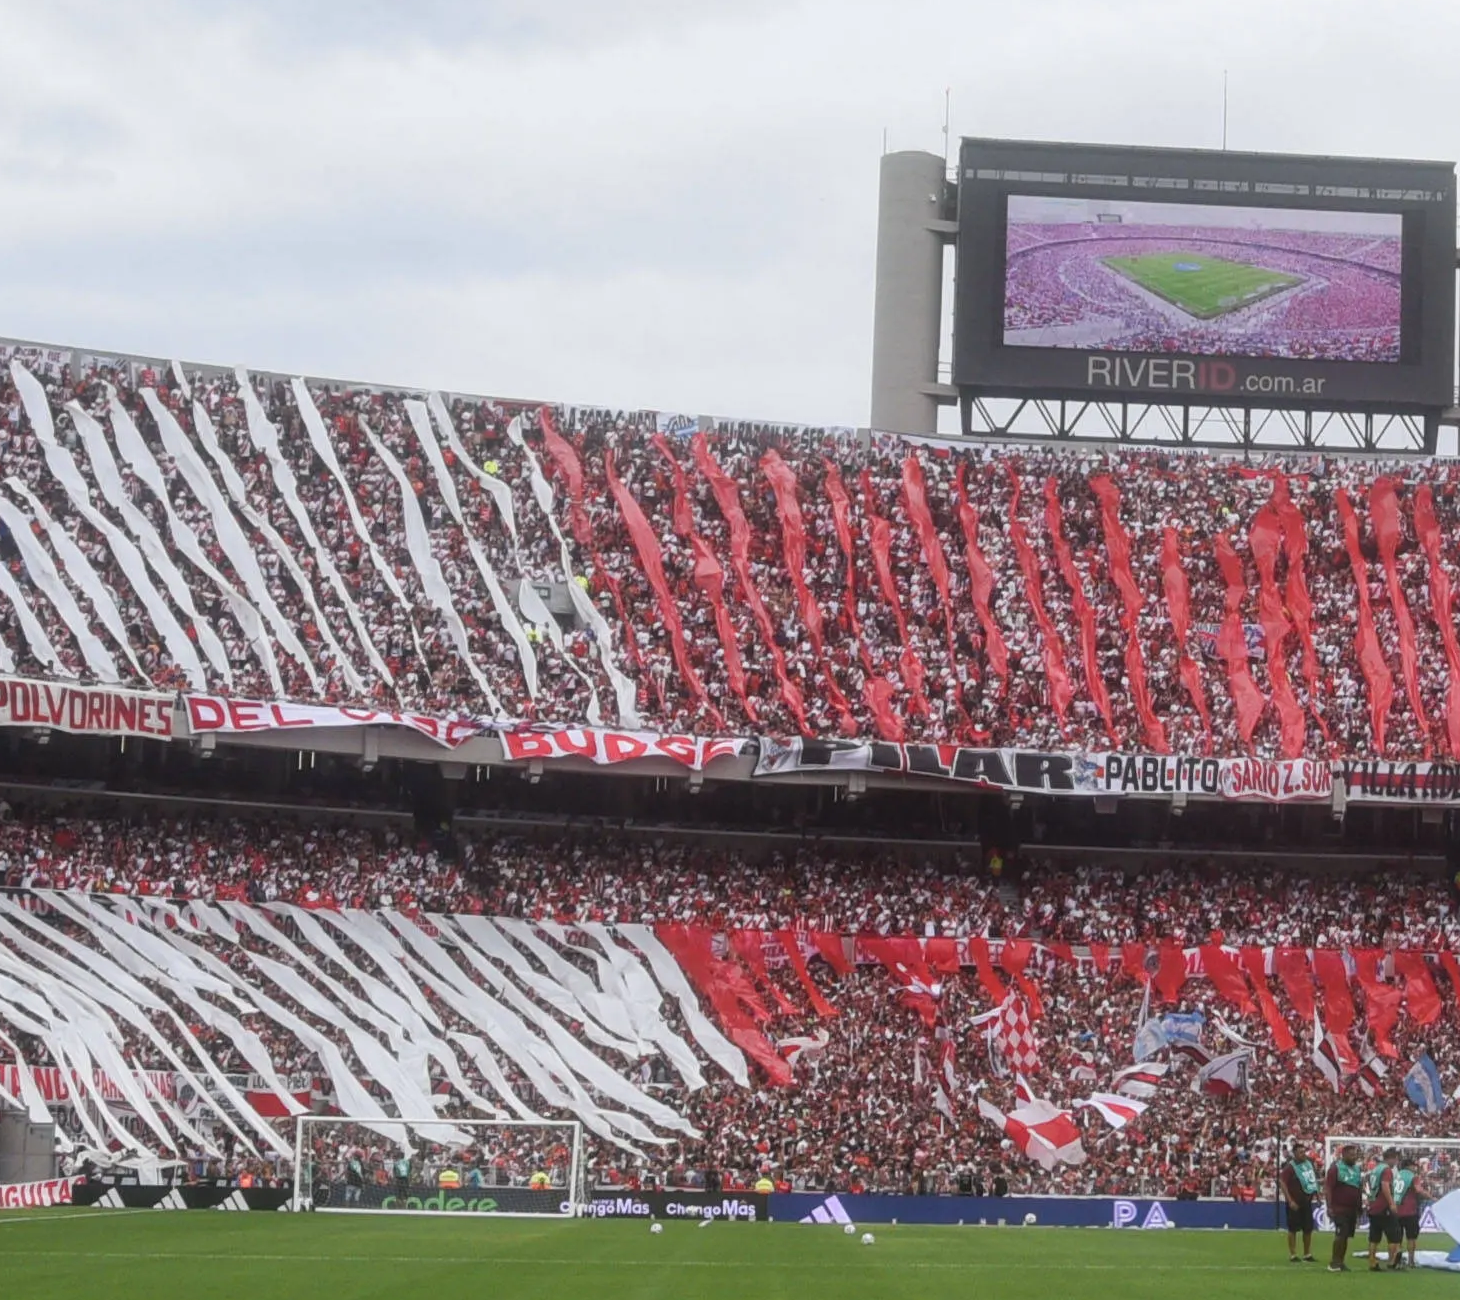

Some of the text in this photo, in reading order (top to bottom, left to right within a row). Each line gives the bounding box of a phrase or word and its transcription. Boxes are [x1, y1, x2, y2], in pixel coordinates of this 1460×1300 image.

[187, 696, 313, 730] DEL
[800, 738, 1075, 790] PILAR
[1106, 756, 1218, 792] PABLITO
